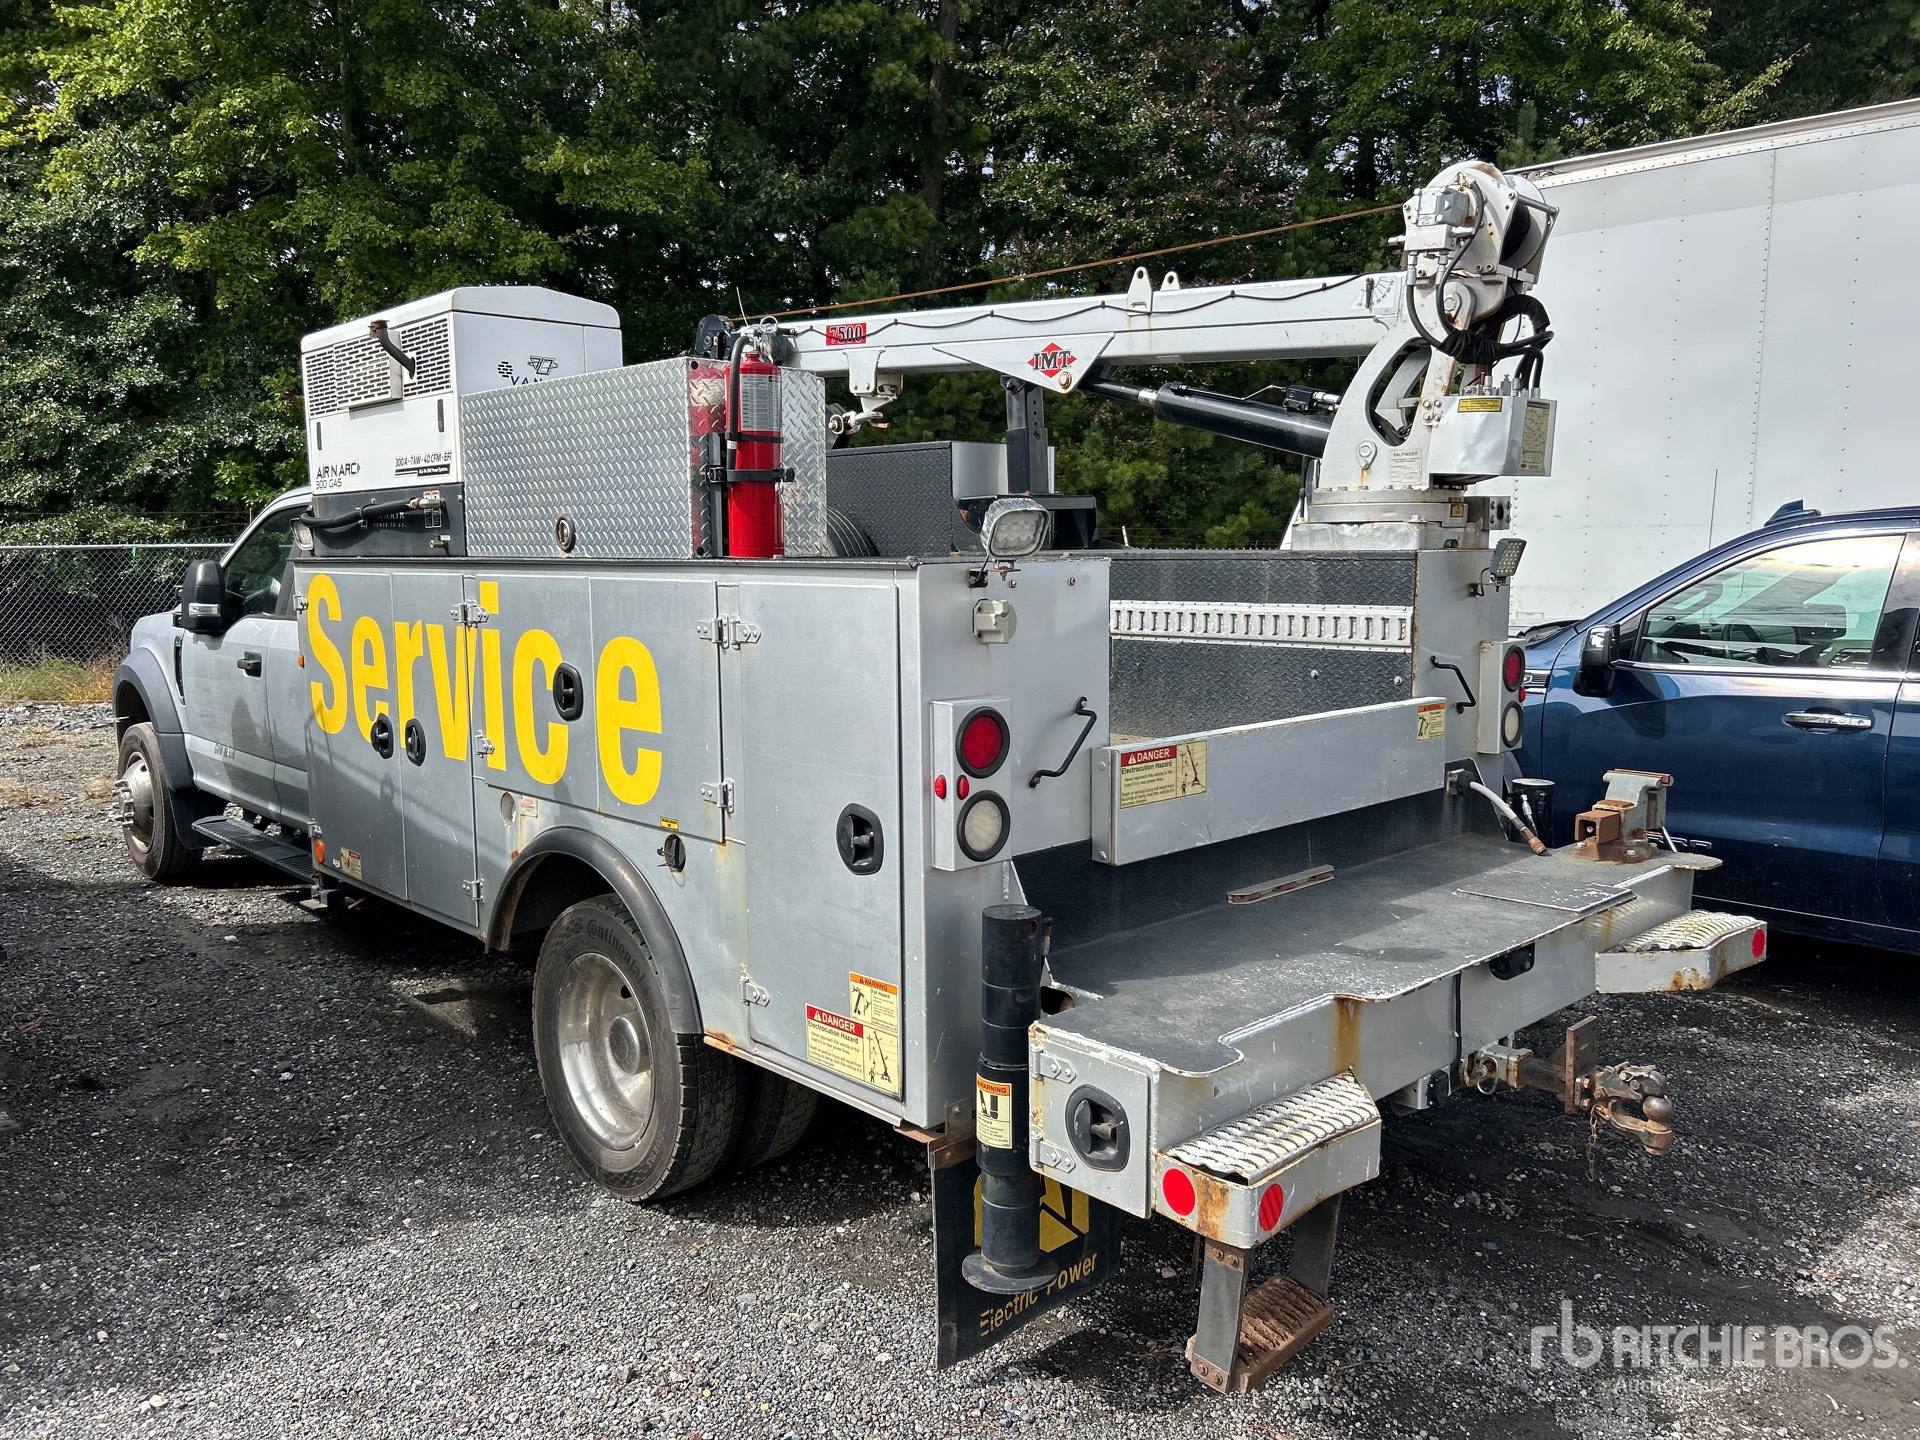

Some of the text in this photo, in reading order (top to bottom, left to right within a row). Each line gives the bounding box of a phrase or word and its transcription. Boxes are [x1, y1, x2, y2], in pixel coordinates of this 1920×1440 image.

[829, 325, 862, 342] 7500
[1033, 350, 1071, 370] IMT
[316, 466, 330, 479] AIR
[331, 464, 338, 478] N
[316, 478, 342, 489] 300 GAS
[307, 574, 662, 805] Service
[1137, 747, 1169, 762] DANGER
[822, 1012, 855, 1033] DANGER
[980, 1081, 1006, 1093] WARNING
[980, 1291, 1038, 1337] Electric
